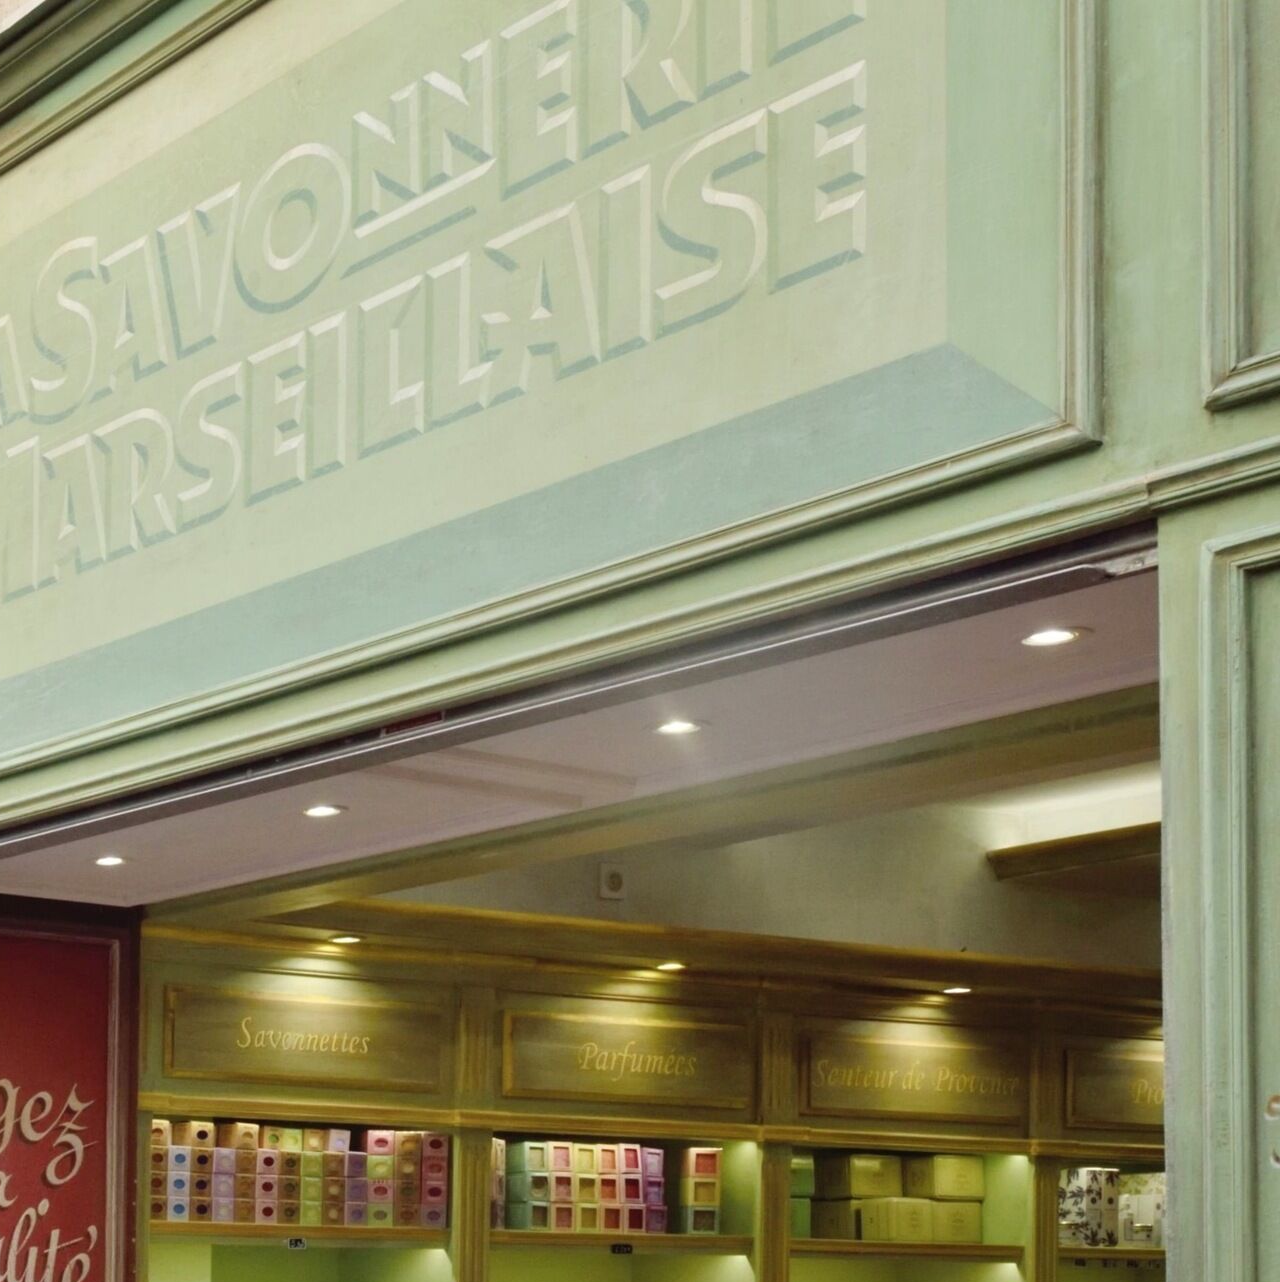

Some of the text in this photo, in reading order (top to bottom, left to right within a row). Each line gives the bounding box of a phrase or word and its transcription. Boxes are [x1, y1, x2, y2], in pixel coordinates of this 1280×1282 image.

[236, 1015, 370, 1055] Savonnettes
[579, 1041, 698, 1081] Parfumées
[902, 1061, 924, 1091] de
